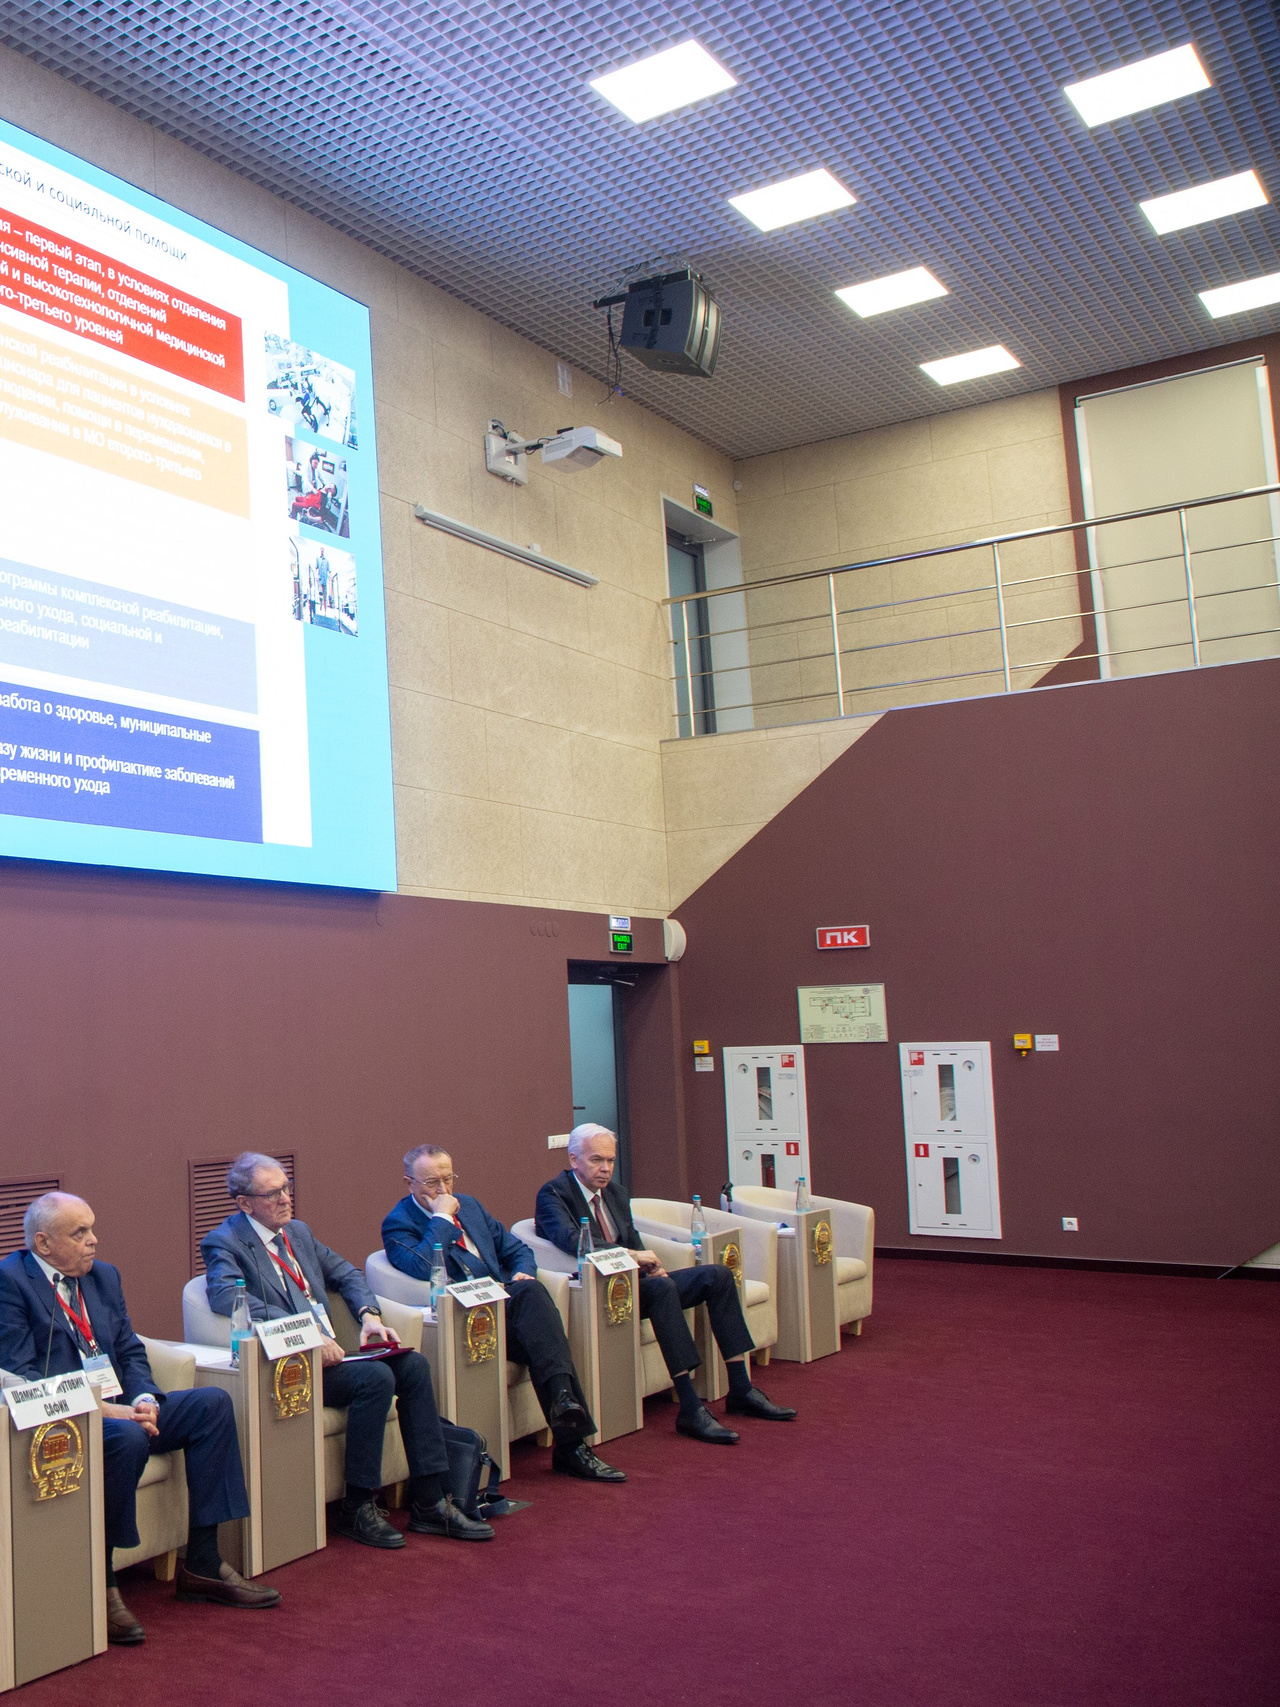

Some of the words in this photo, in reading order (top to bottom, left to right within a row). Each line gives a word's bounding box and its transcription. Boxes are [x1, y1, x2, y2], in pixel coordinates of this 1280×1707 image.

[36, 180, 44, 193] и
[49, 186, 131, 235] социальной
[135, 228, 187, 264] помощи
[25, 230, 72, 261] первый
[74, 253, 105, 278] этап,
[107, 267, 115, 280] в
[117, 271, 170, 305] условиях
[171, 297, 226, 330] отделения
[51, 263, 105, 298] терапии,
[106, 288, 167, 323] отделений
[11, 267, 20, 281] и
[23, 272, 153, 337] высокотехнологичной
[155, 328, 225, 368] медицинской
[73, 314, 123, 345] уровней
[36, 603, 78, 626] ухода,
[80, 614, 152, 641] социальной
[154, 631, 162, 644] и
[60, 586, 140, 616] комплексной
[142, 606, 223, 640] реабилитации,
[43, 702, 53, 715] о
[55, 704, 117, 729] здоровье,
[120, 715, 211, 743] муниципальные
[19, 745, 61, 763] жизни
[63, 752, 72, 765] и
[75, 754, 162, 778] профилактике
[164, 766, 235, 789] заболеваний
[73, 777, 110, 795] ухода
[825, 930, 859, 945] ПК
[43, 1399, 70, 1417] САФИН
